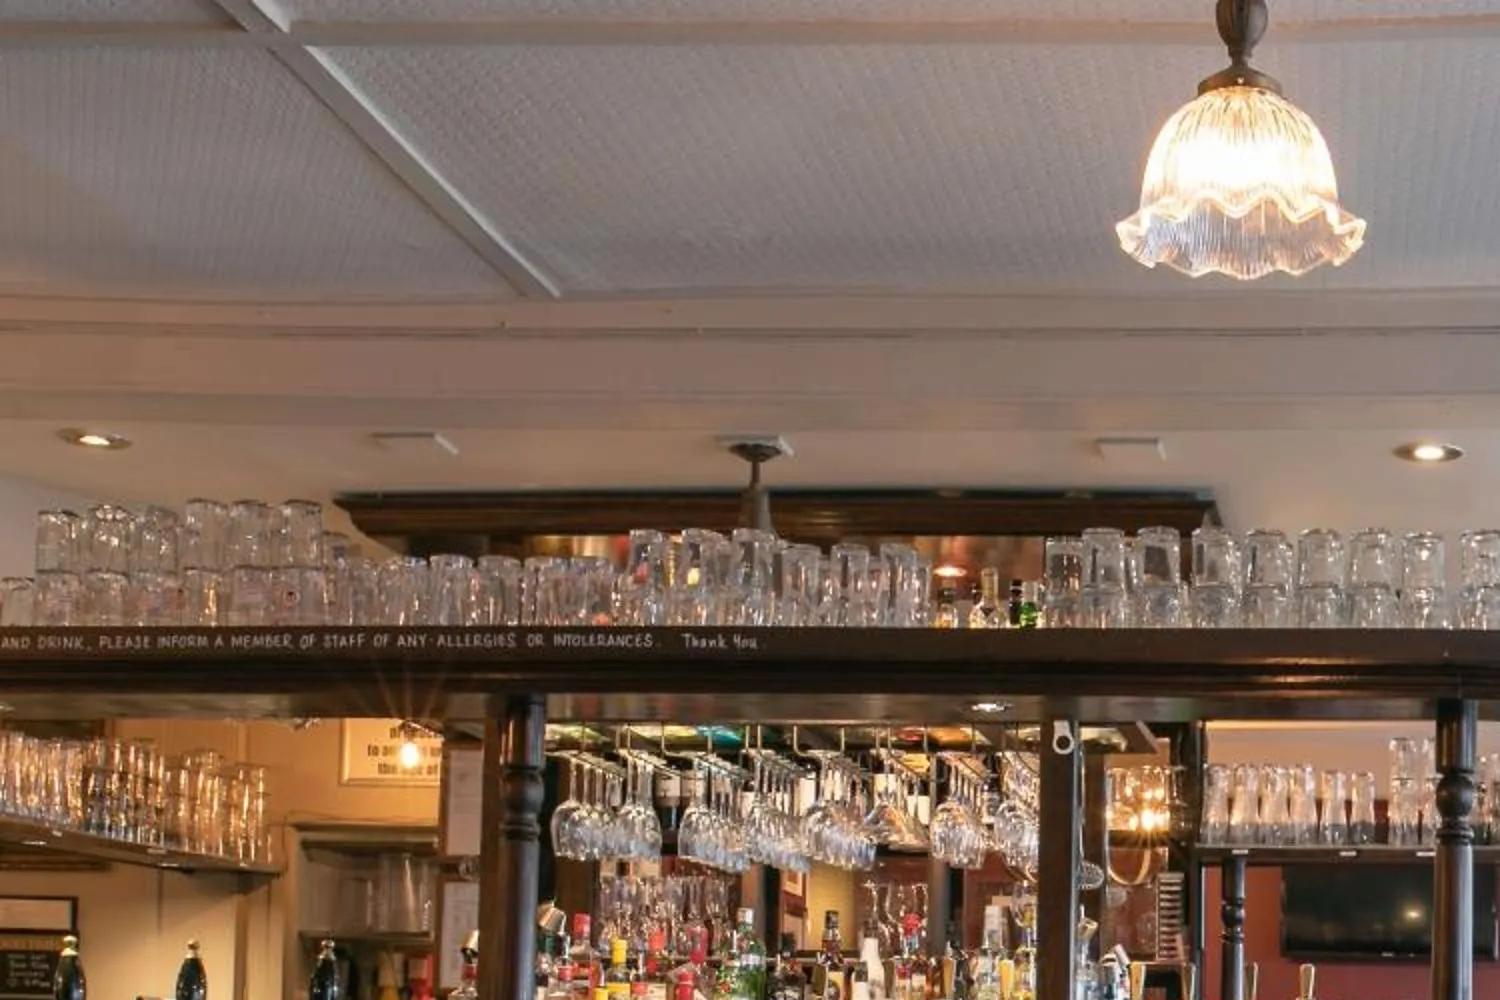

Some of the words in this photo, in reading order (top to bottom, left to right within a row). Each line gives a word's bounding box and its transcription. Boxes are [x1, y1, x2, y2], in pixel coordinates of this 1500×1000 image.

[1, 635, 31, 650] AND
[99, 634, 150, 650] PLEASE
[157, 634, 208, 649] INFORM
[214, 635, 225, 649] A
[231, 634, 294, 649] MEMBER
[300, 635, 317, 649] OF
[322, 634, 366, 648] STAFF
[373, 634, 389, 648] OF
[437, 633, 517, 648] ALLERGIES
[527, 633, 544, 648] OR
